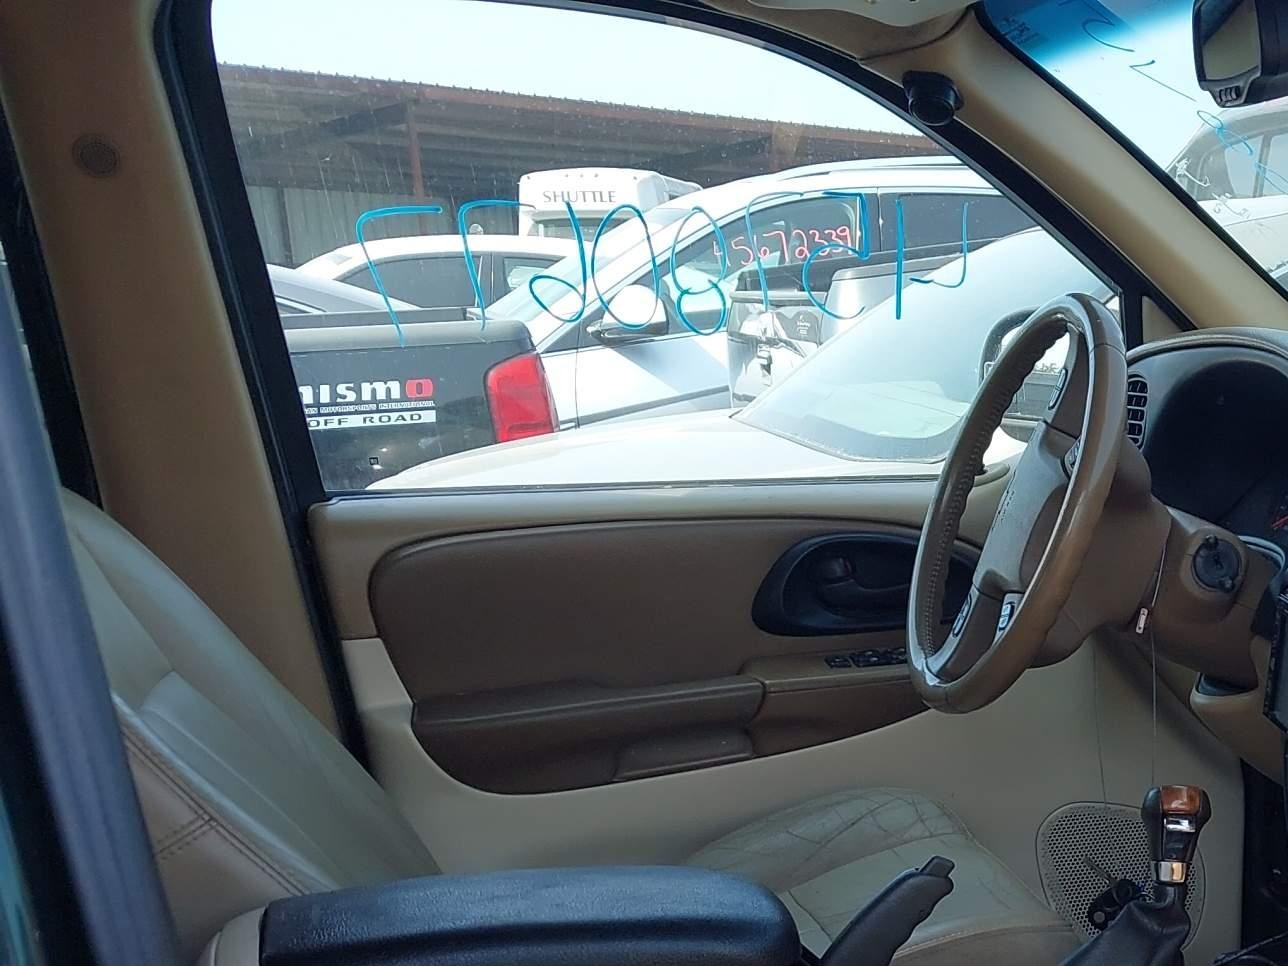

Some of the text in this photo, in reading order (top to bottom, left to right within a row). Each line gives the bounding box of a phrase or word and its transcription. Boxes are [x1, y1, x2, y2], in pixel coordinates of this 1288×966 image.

[542, 190, 617, 203] SHUTTLE
[712, 225, 852, 267] 45672339
[308, 413, 422, 428] OFF ROAD
